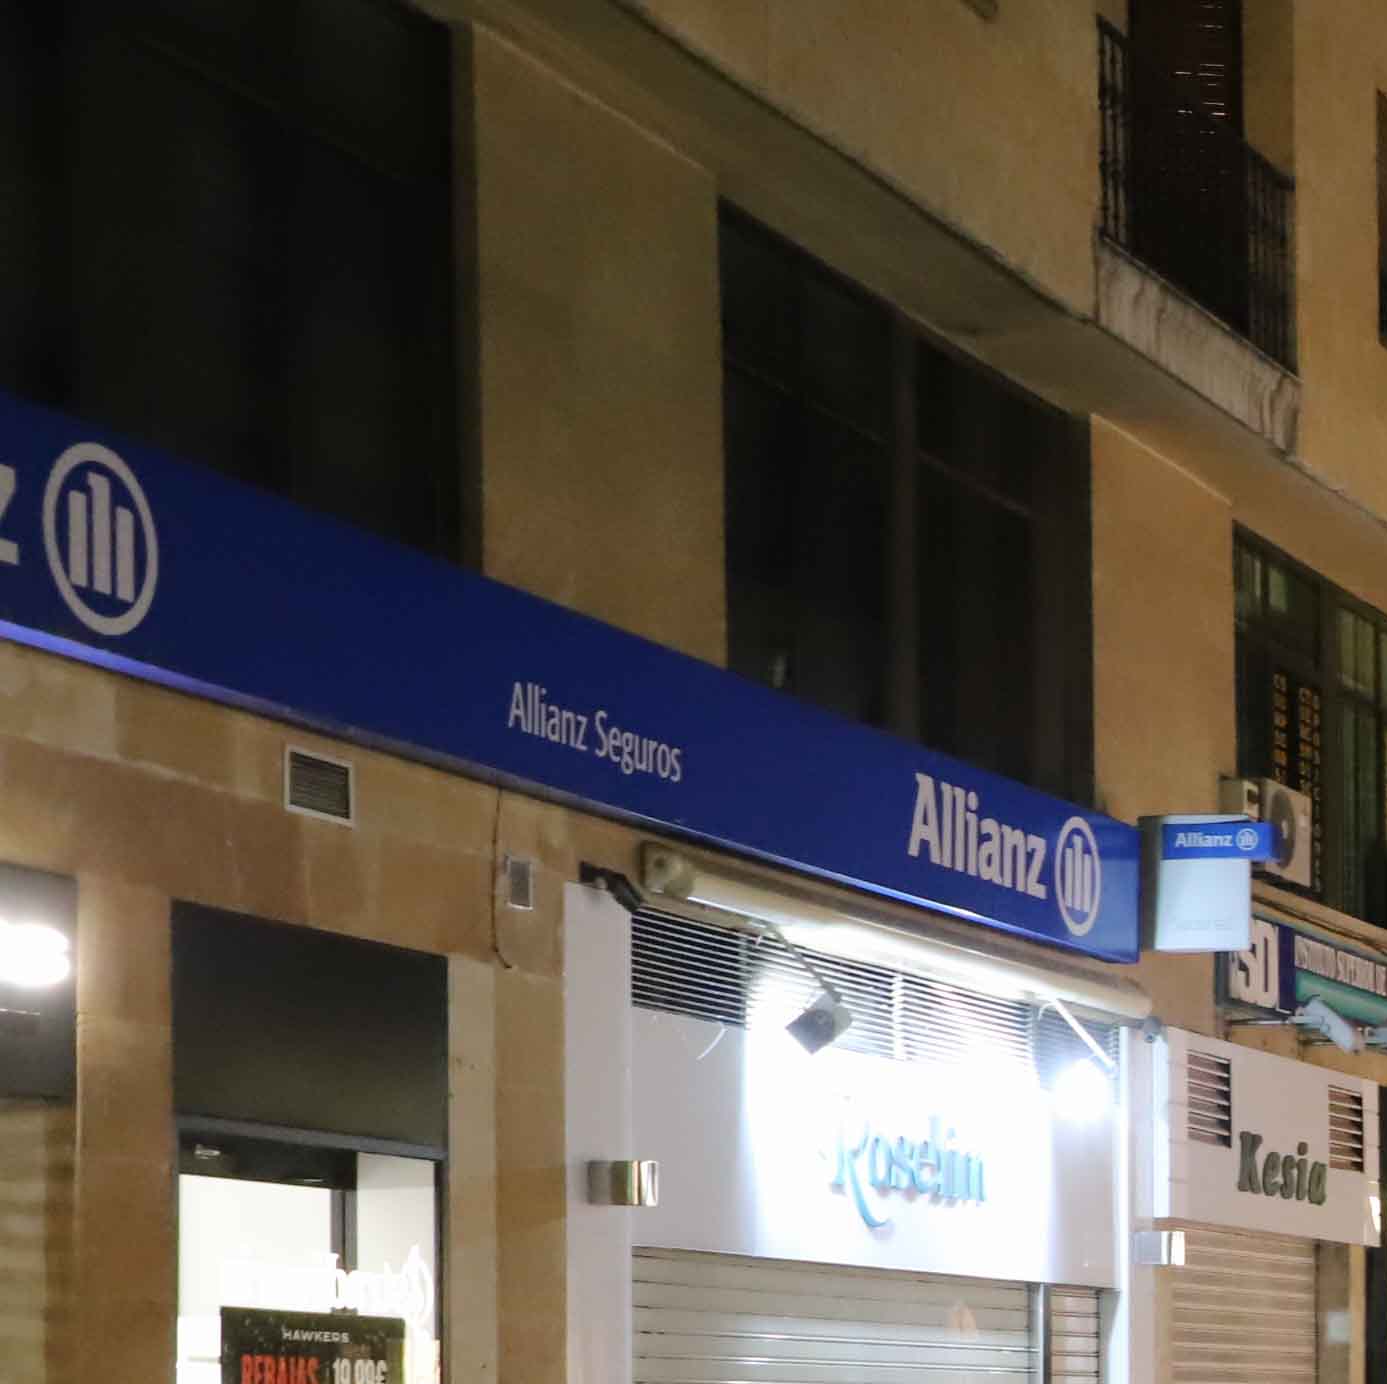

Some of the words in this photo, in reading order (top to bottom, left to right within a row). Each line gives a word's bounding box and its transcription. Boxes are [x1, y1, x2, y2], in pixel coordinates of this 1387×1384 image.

[508, 681, 589, 750] Allianz
[595, 708, 682, 783] Seguros
[907, 771, 1047, 898] Allianz
[1175, 832, 1233, 848] Allianz
[1238, 1131, 1327, 1205] Kesia
[281, 1329, 350, 1343] HAWKERS
